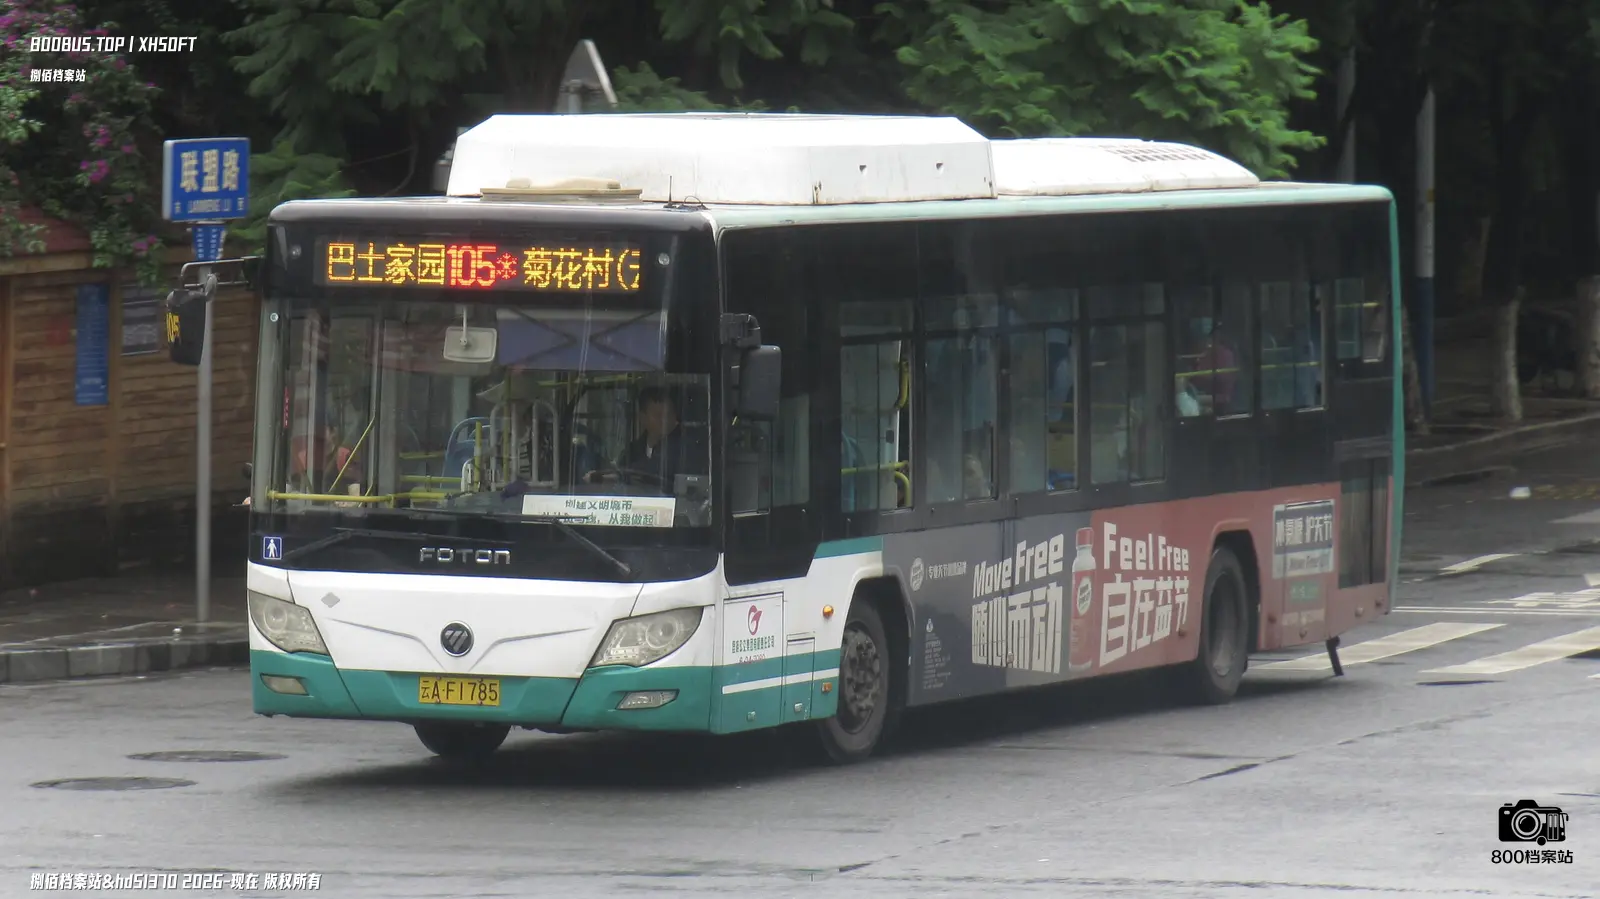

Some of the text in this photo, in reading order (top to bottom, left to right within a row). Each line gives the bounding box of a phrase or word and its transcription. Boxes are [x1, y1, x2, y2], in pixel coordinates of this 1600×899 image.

[180, 149, 240, 192] 联盟路
[328, 242, 446, 285] 巴士家园
[447, 245, 497, 286] 105
[419, 547, 511, 564] FOTON
[973, 557, 1012, 598] Move
[1015, 533, 1065, 585] Free
[1103, 522, 1190, 571] Feel Free
[1100, 573, 1190, 668] 自在益节
